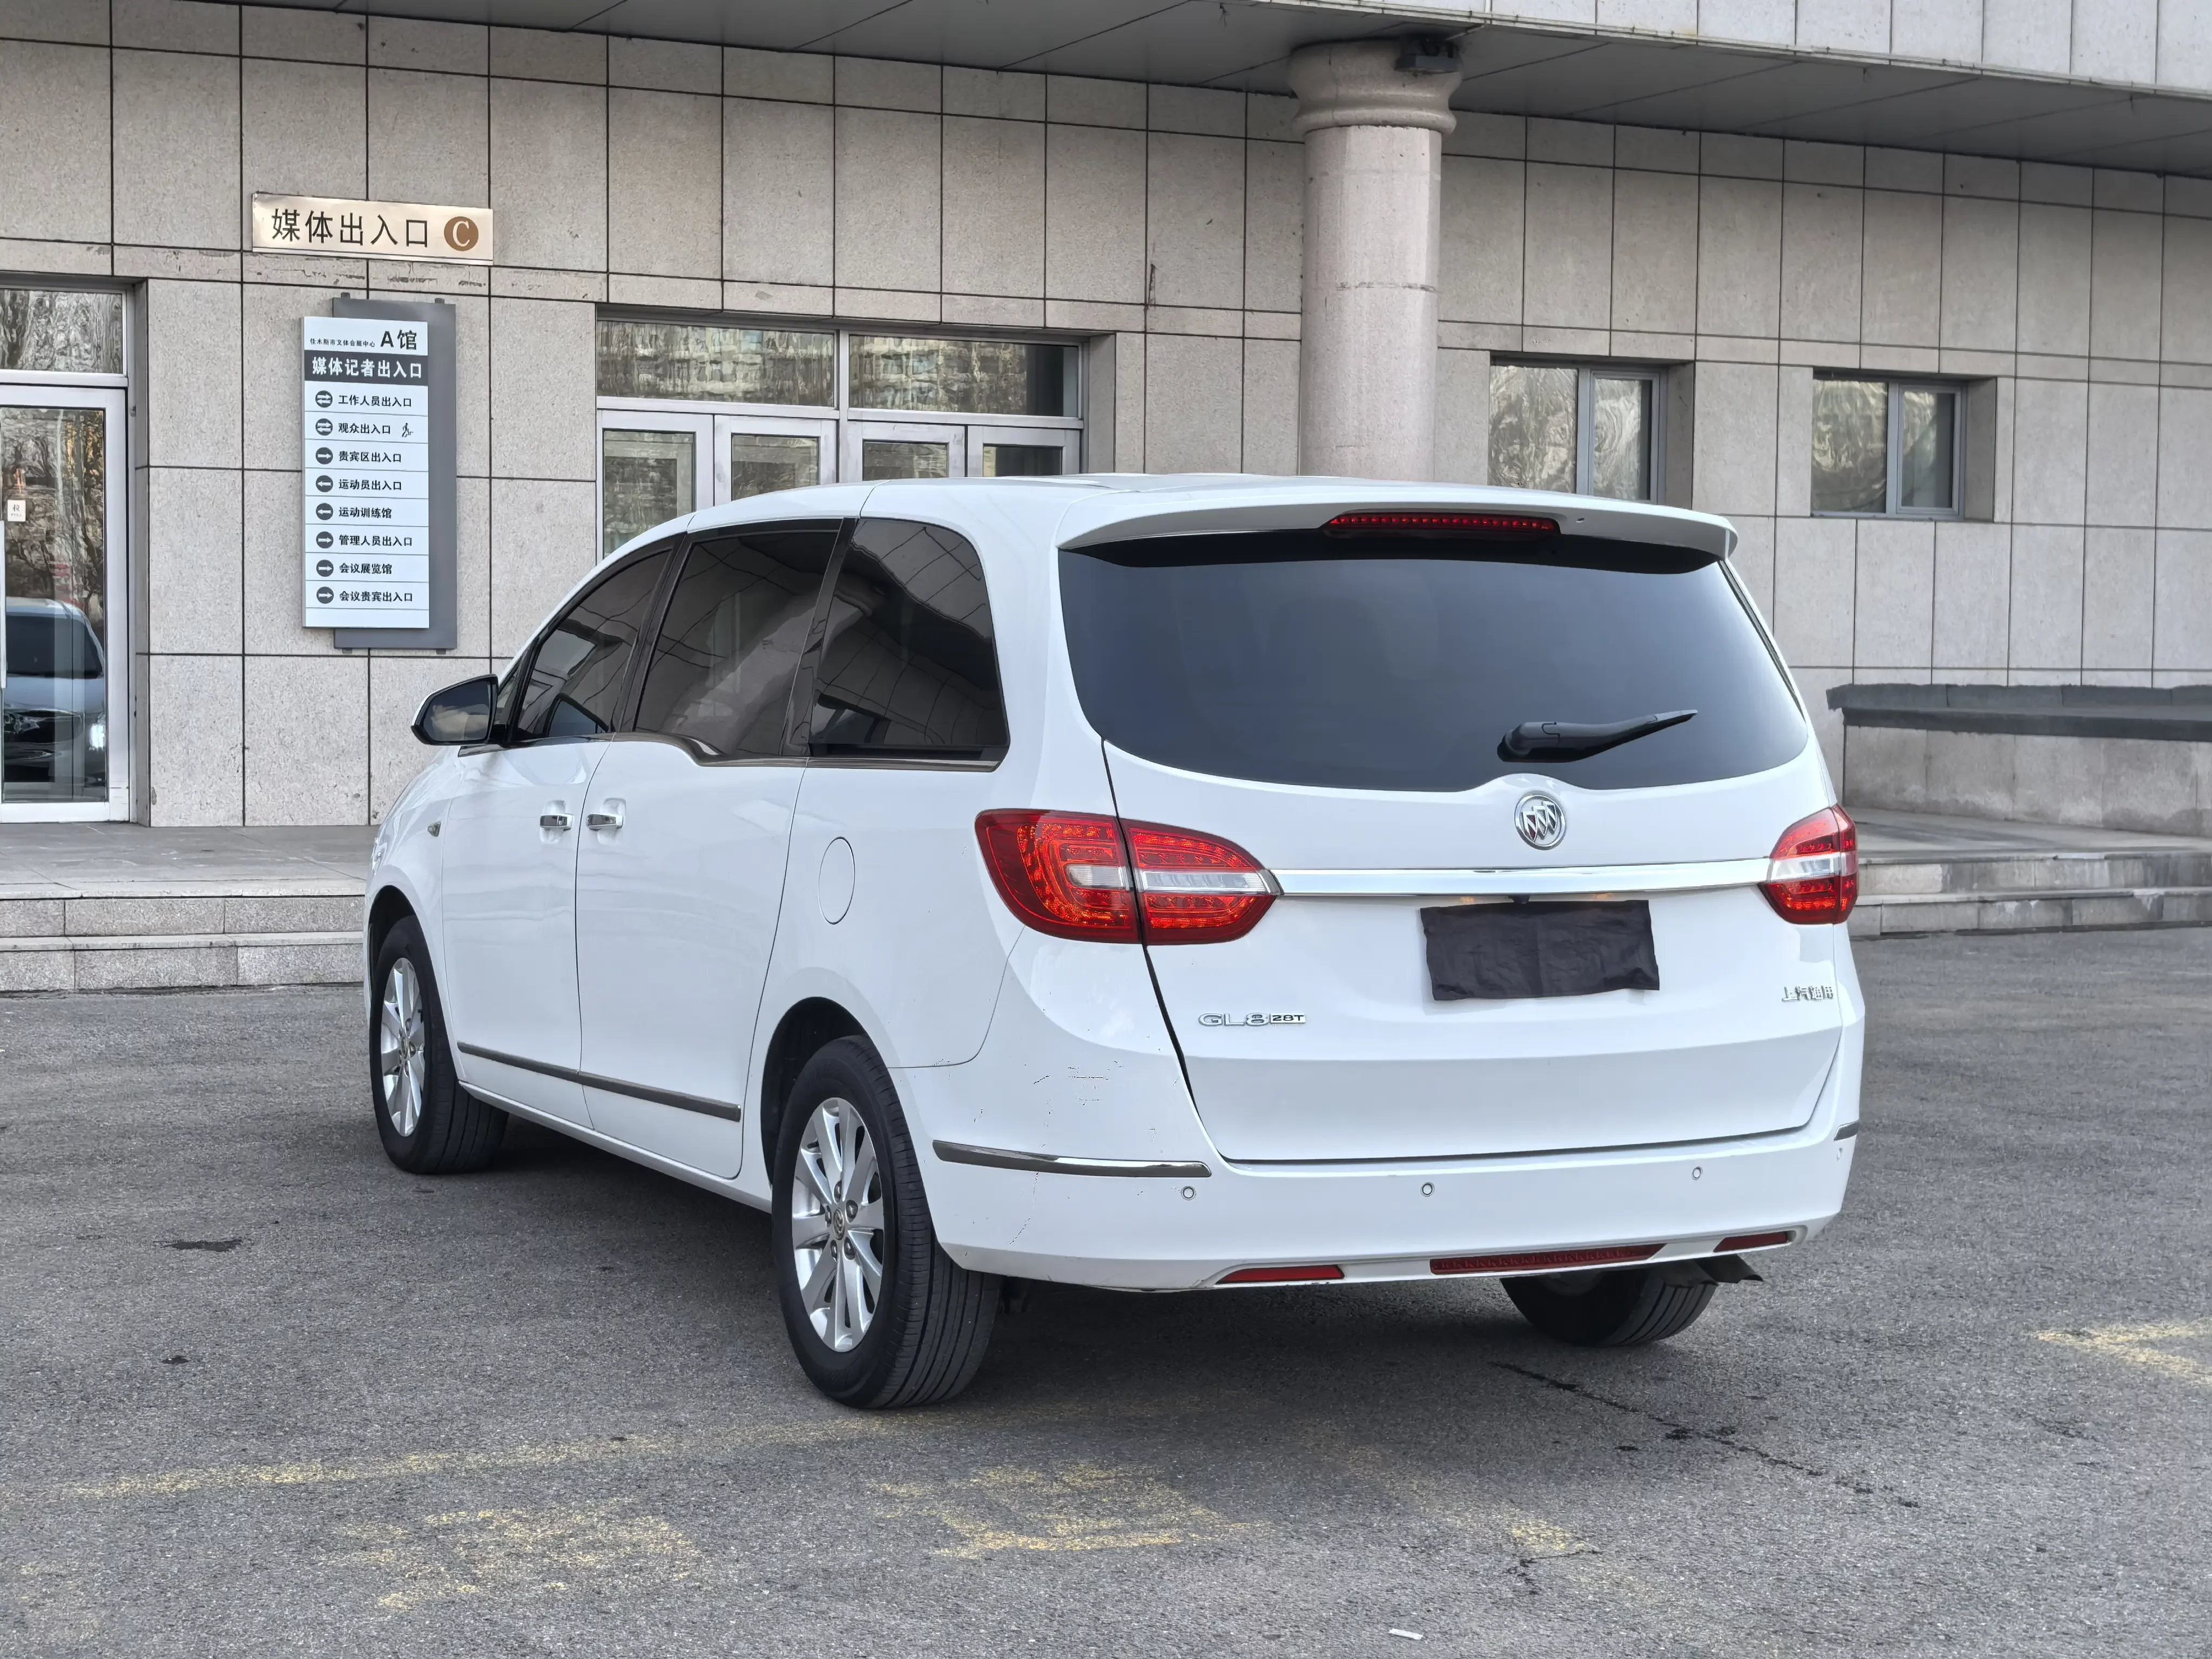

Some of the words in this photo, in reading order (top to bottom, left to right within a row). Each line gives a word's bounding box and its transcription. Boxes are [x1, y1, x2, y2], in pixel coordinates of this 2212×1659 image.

[272, 208, 428, 247] 媒体出入口
[453, 220, 470, 247] C
[380, 329, 417, 350] A馆
[312, 356, 422, 378] 媒体记者出入口
[338, 395, 412, 407] 工作人员出入口
[338, 423, 390, 434] 观众出入口
[339, 451, 402, 463] 贵宾区出入口
[339, 479, 402, 490] 运动员出入口
[339, 507, 392, 518] 运动训练馆
[339, 535, 412, 547] 管理人员出入口
[339, 562, 392, 575] 会议展览馆
[339, 591, 413, 602] 会议贵宾出入口
